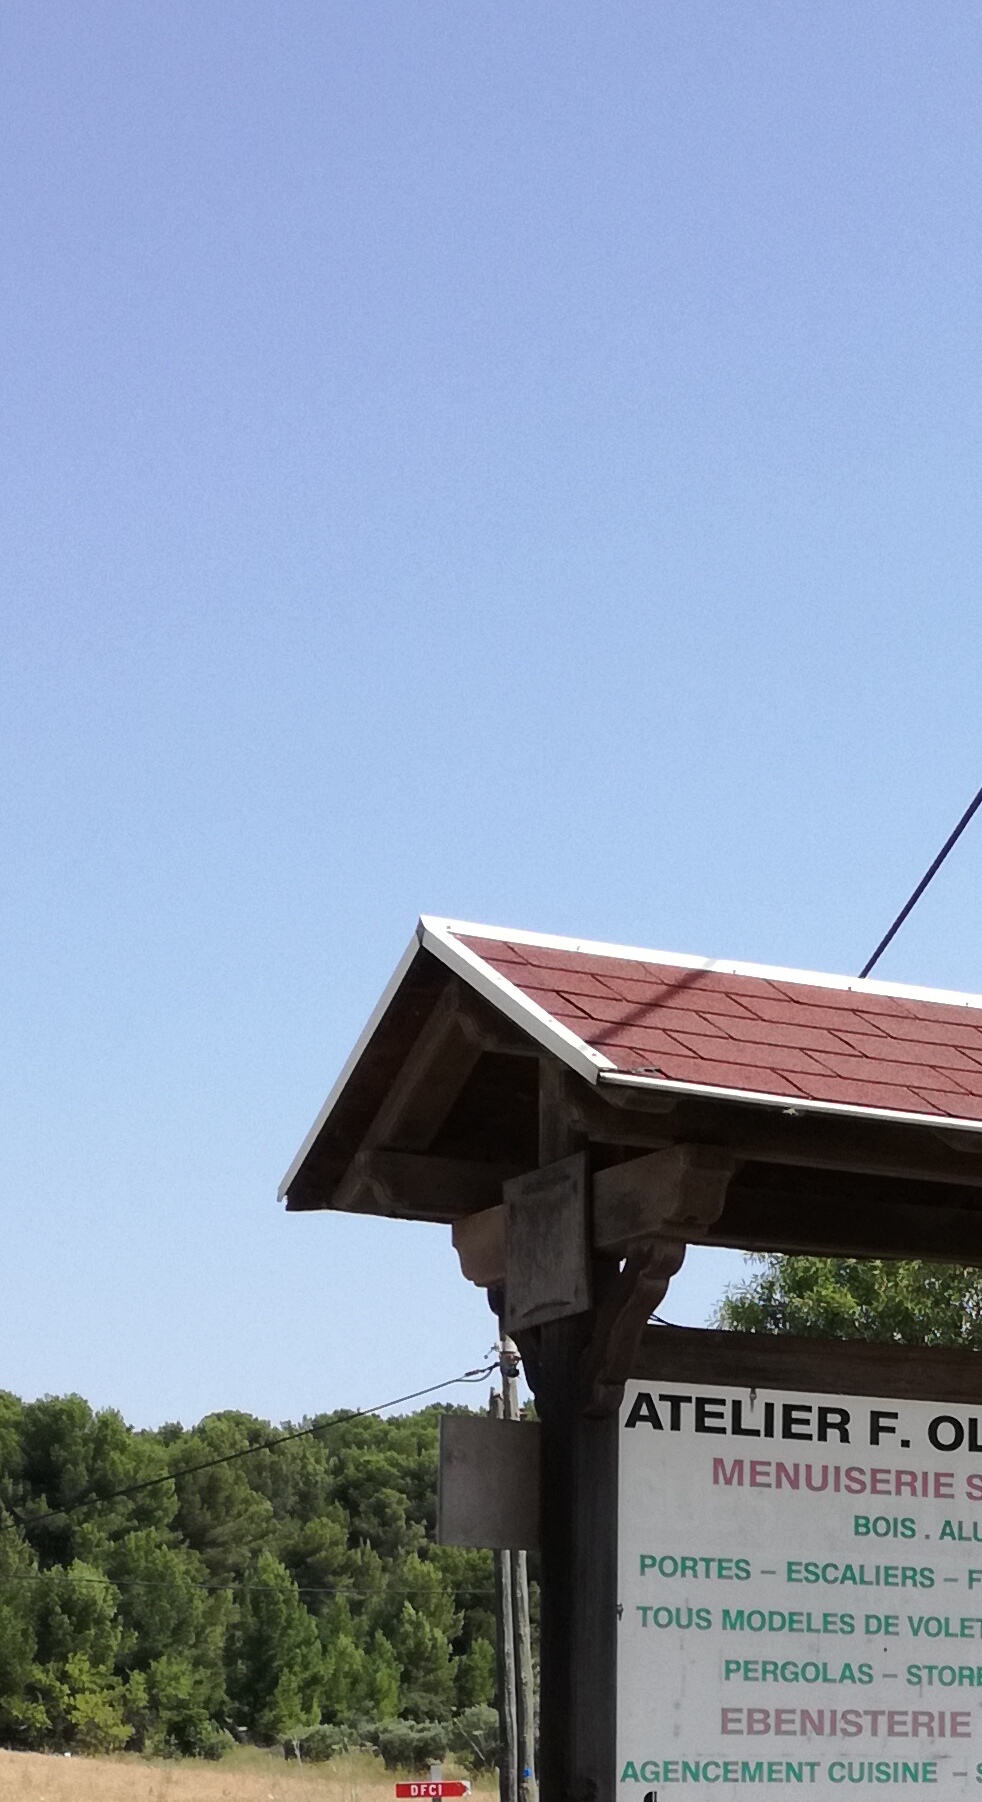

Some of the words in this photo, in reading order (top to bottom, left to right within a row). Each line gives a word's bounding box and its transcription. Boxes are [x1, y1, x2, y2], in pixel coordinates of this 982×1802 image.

[624, 1391, 851, 1443] ATELIER
[870, 1410, 910, 1448] F.
[713, 1458, 954, 1499] MENUISERIE
[854, 1515, 916, 1539] BOIS
[640, 1554, 751, 1580] PORTES
[787, 1561, 935, 1588] ESCALIERS
[636, 1606, 712, 1630] TOUS
[722, 1609, 855, 1634] MODELES
[865, 1614, 899, 1636] DE
[725, 1660, 874, 1685] PERGOLAS
[721, 1708, 971, 1739] EBENISTERIE
[620, 1761, 820, 1783] AGENCEMENT
[828, 1762, 937, 1783] CUISINE
[410, 1784, 443, 1796] DFCI
